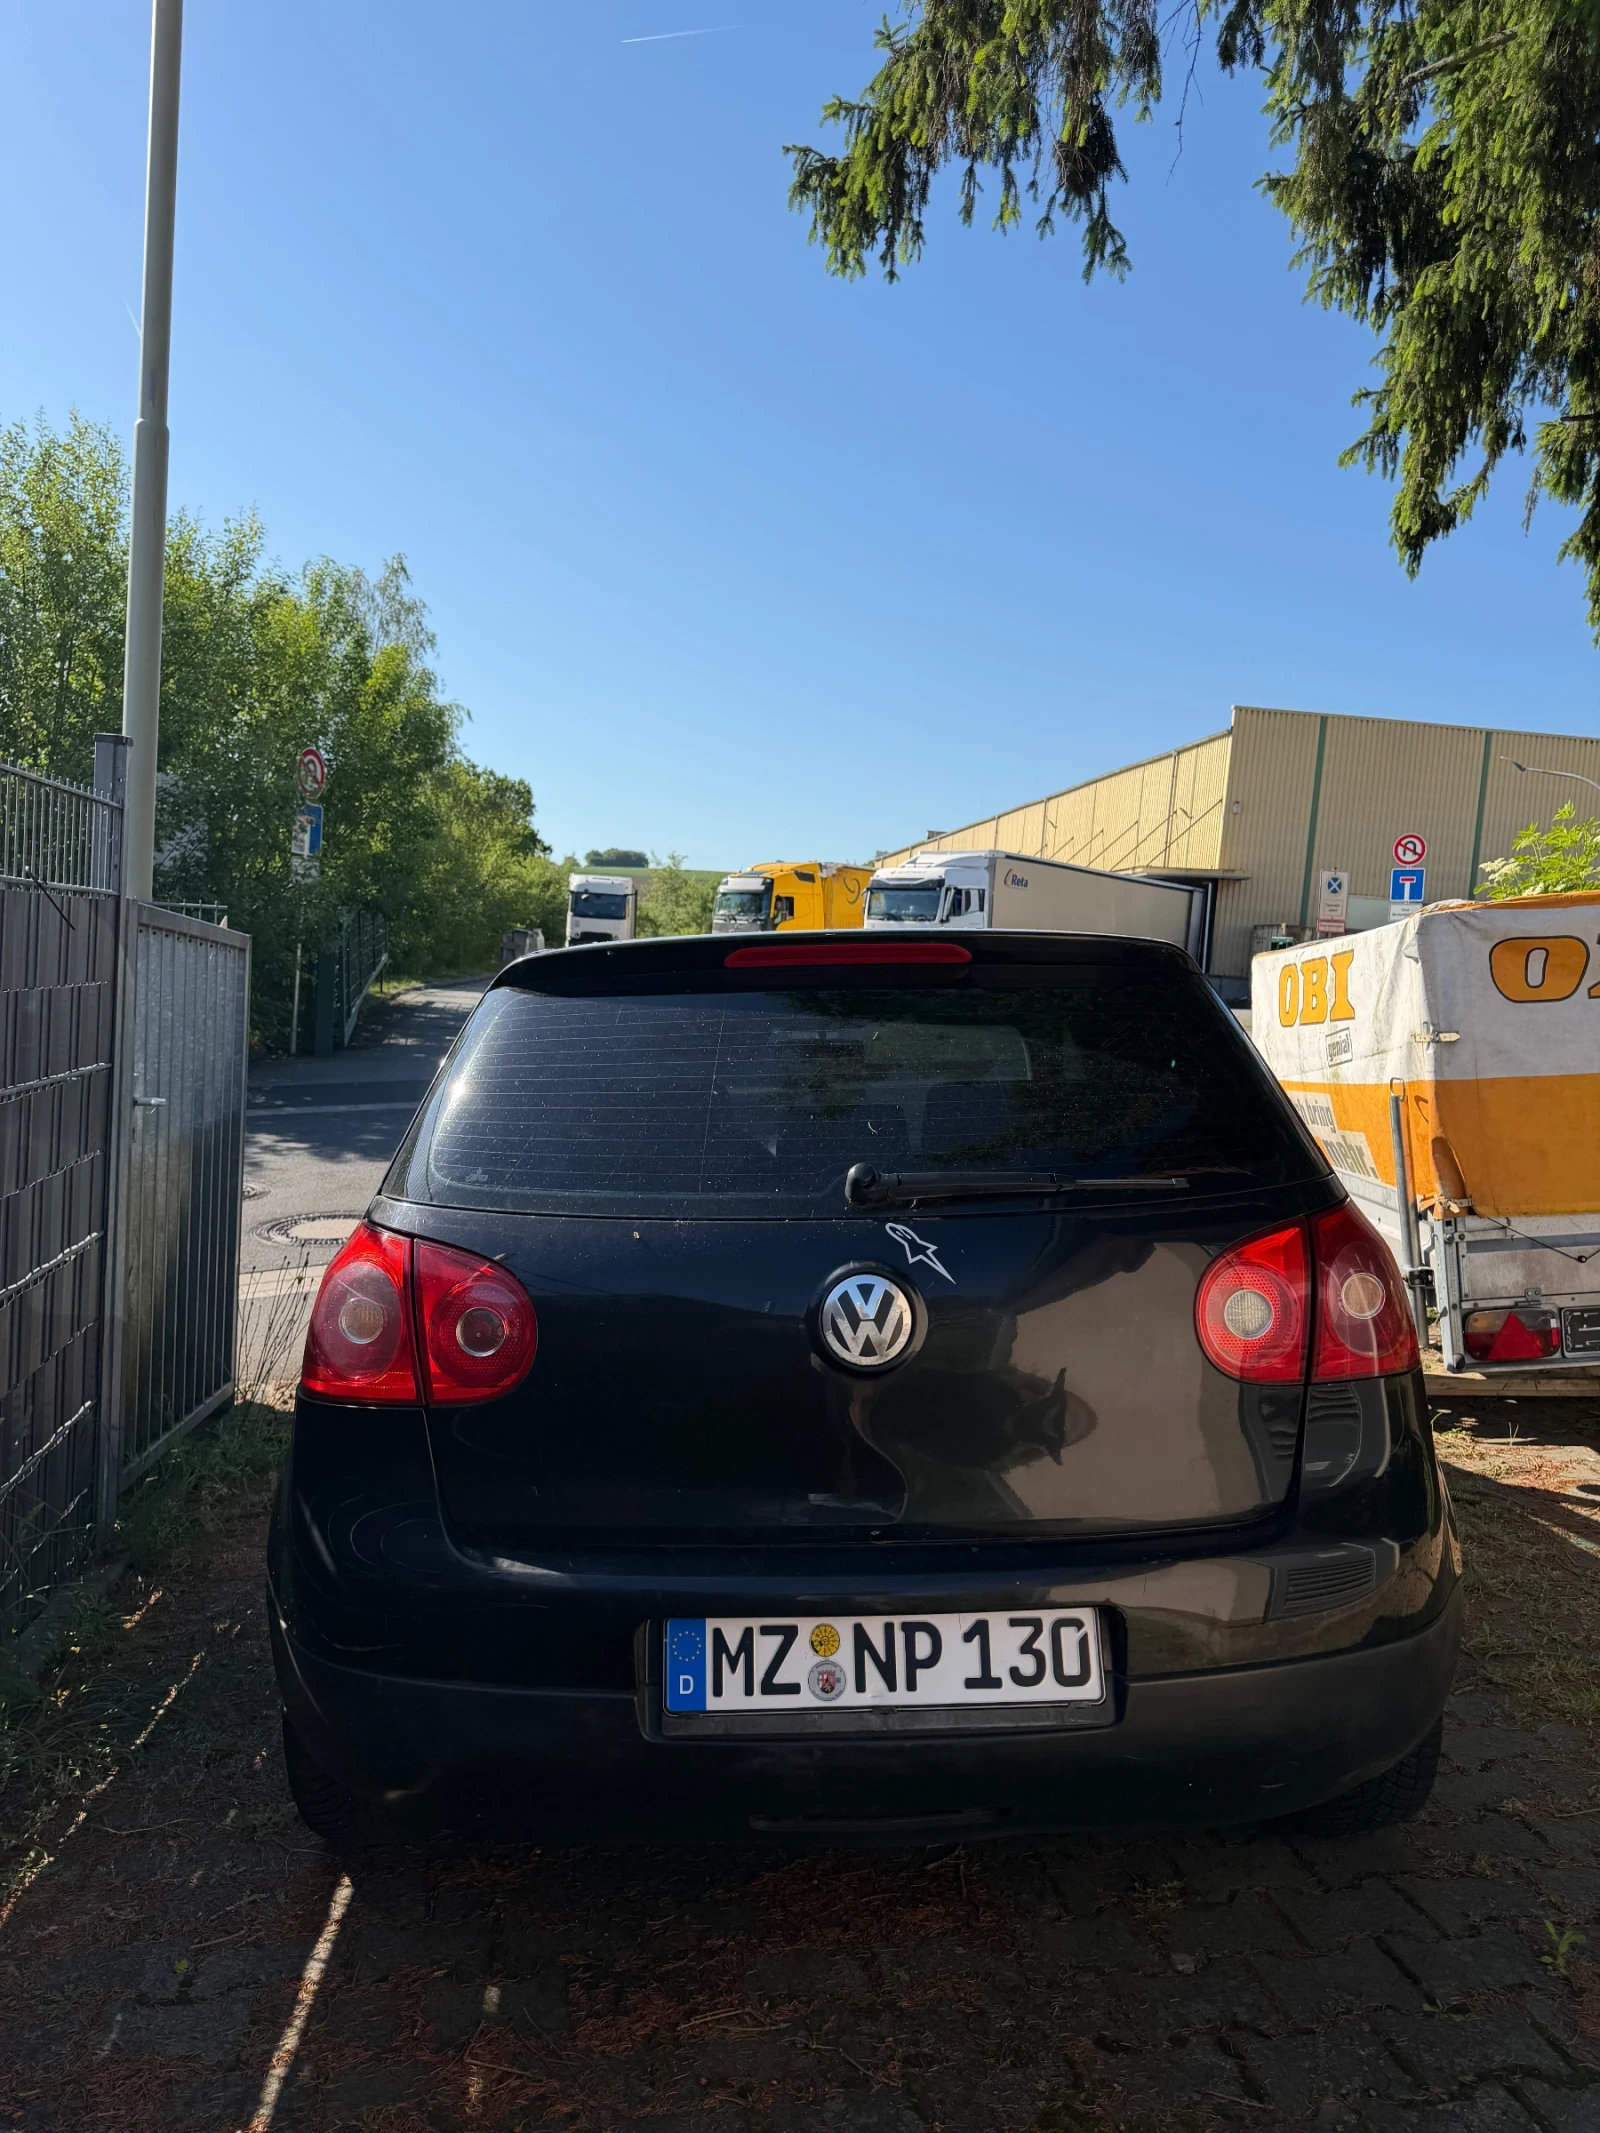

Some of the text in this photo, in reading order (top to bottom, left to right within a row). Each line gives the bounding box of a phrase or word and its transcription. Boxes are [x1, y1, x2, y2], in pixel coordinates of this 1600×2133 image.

[1011, 874, 1029, 888] Reta
[1279, 949, 1355, 1027] OBI
[1328, 1034, 1351, 1061] genial
[1305, 1099, 1337, 1133] bring
[1322, 1135, 1379, 1179] mehr.
[712, 1624, 801, 1697] MZ
[853, 1621, 943, 1693] NP
[962, 1617, 1092, 1689] 130
[679, 1674, 694, 1694] D
